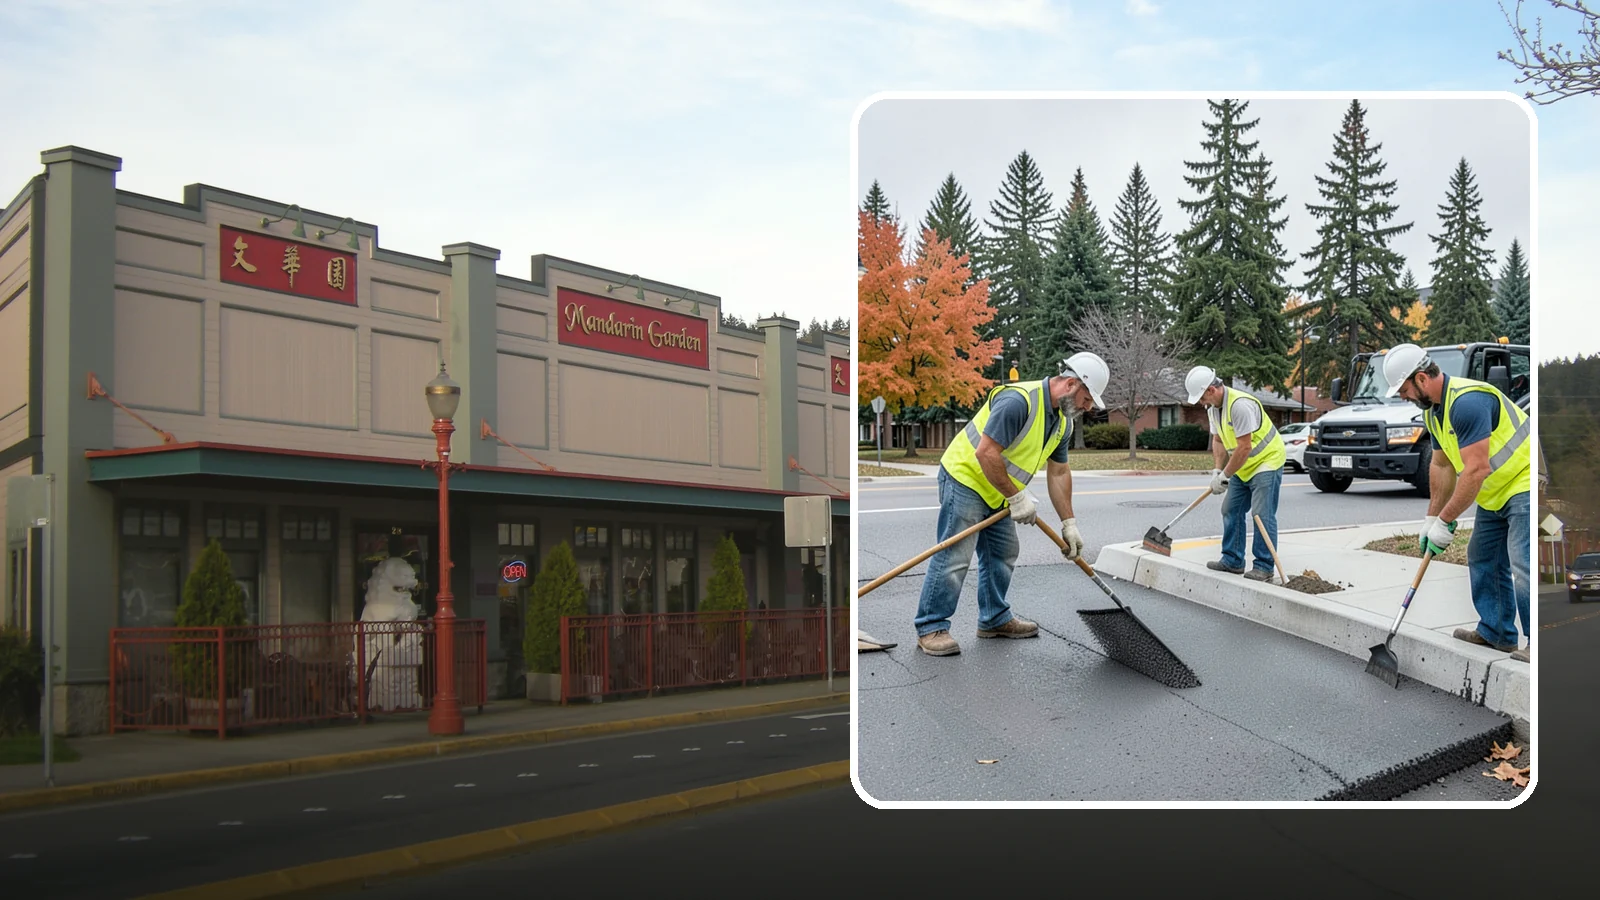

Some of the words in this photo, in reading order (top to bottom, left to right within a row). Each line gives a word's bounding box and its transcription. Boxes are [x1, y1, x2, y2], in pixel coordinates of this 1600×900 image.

[230, 236, 346, 291] 文華園
[564, 302, 644, 341] Mandarin
[647, 319, 702, 352] Garden
[503, 565, 527, 578] OPEN
